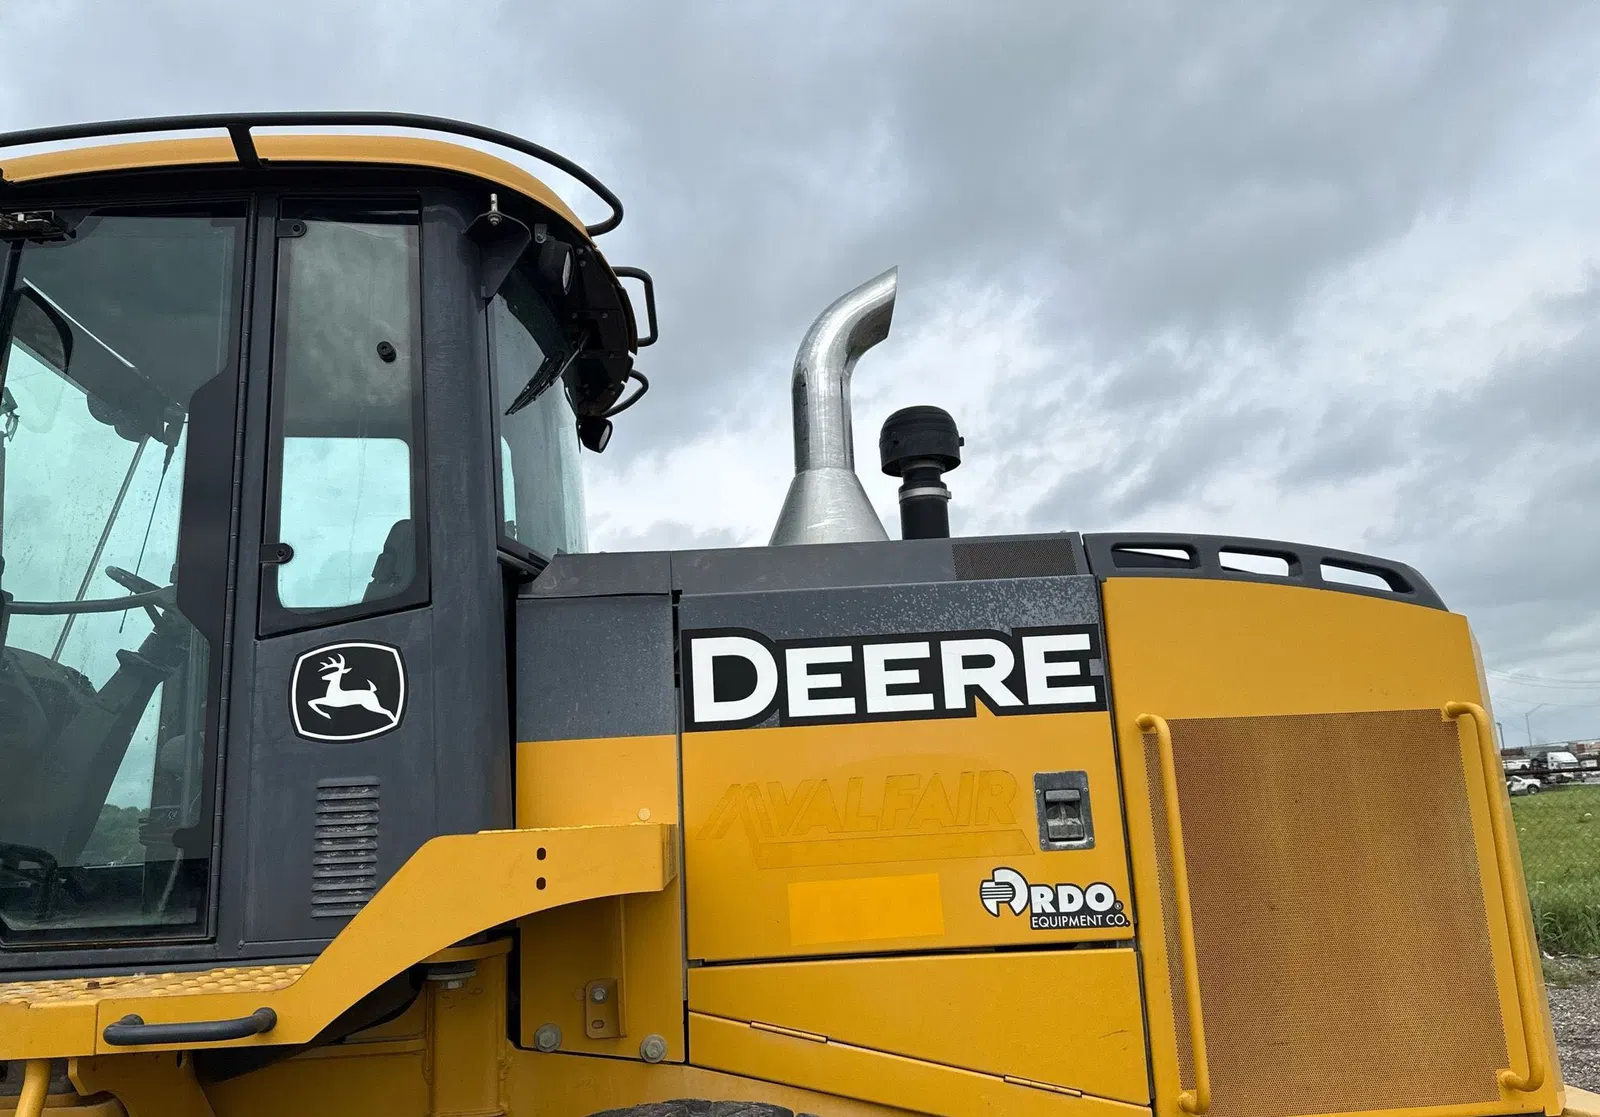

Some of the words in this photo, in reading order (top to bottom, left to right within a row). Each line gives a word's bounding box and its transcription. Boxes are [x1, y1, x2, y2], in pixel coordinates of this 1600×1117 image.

[690, 633, 1097, 723] DEERE
[1031, 915, 1103, 928] EQUIPMENT
[1106, 913, 1129, 926] CO.
